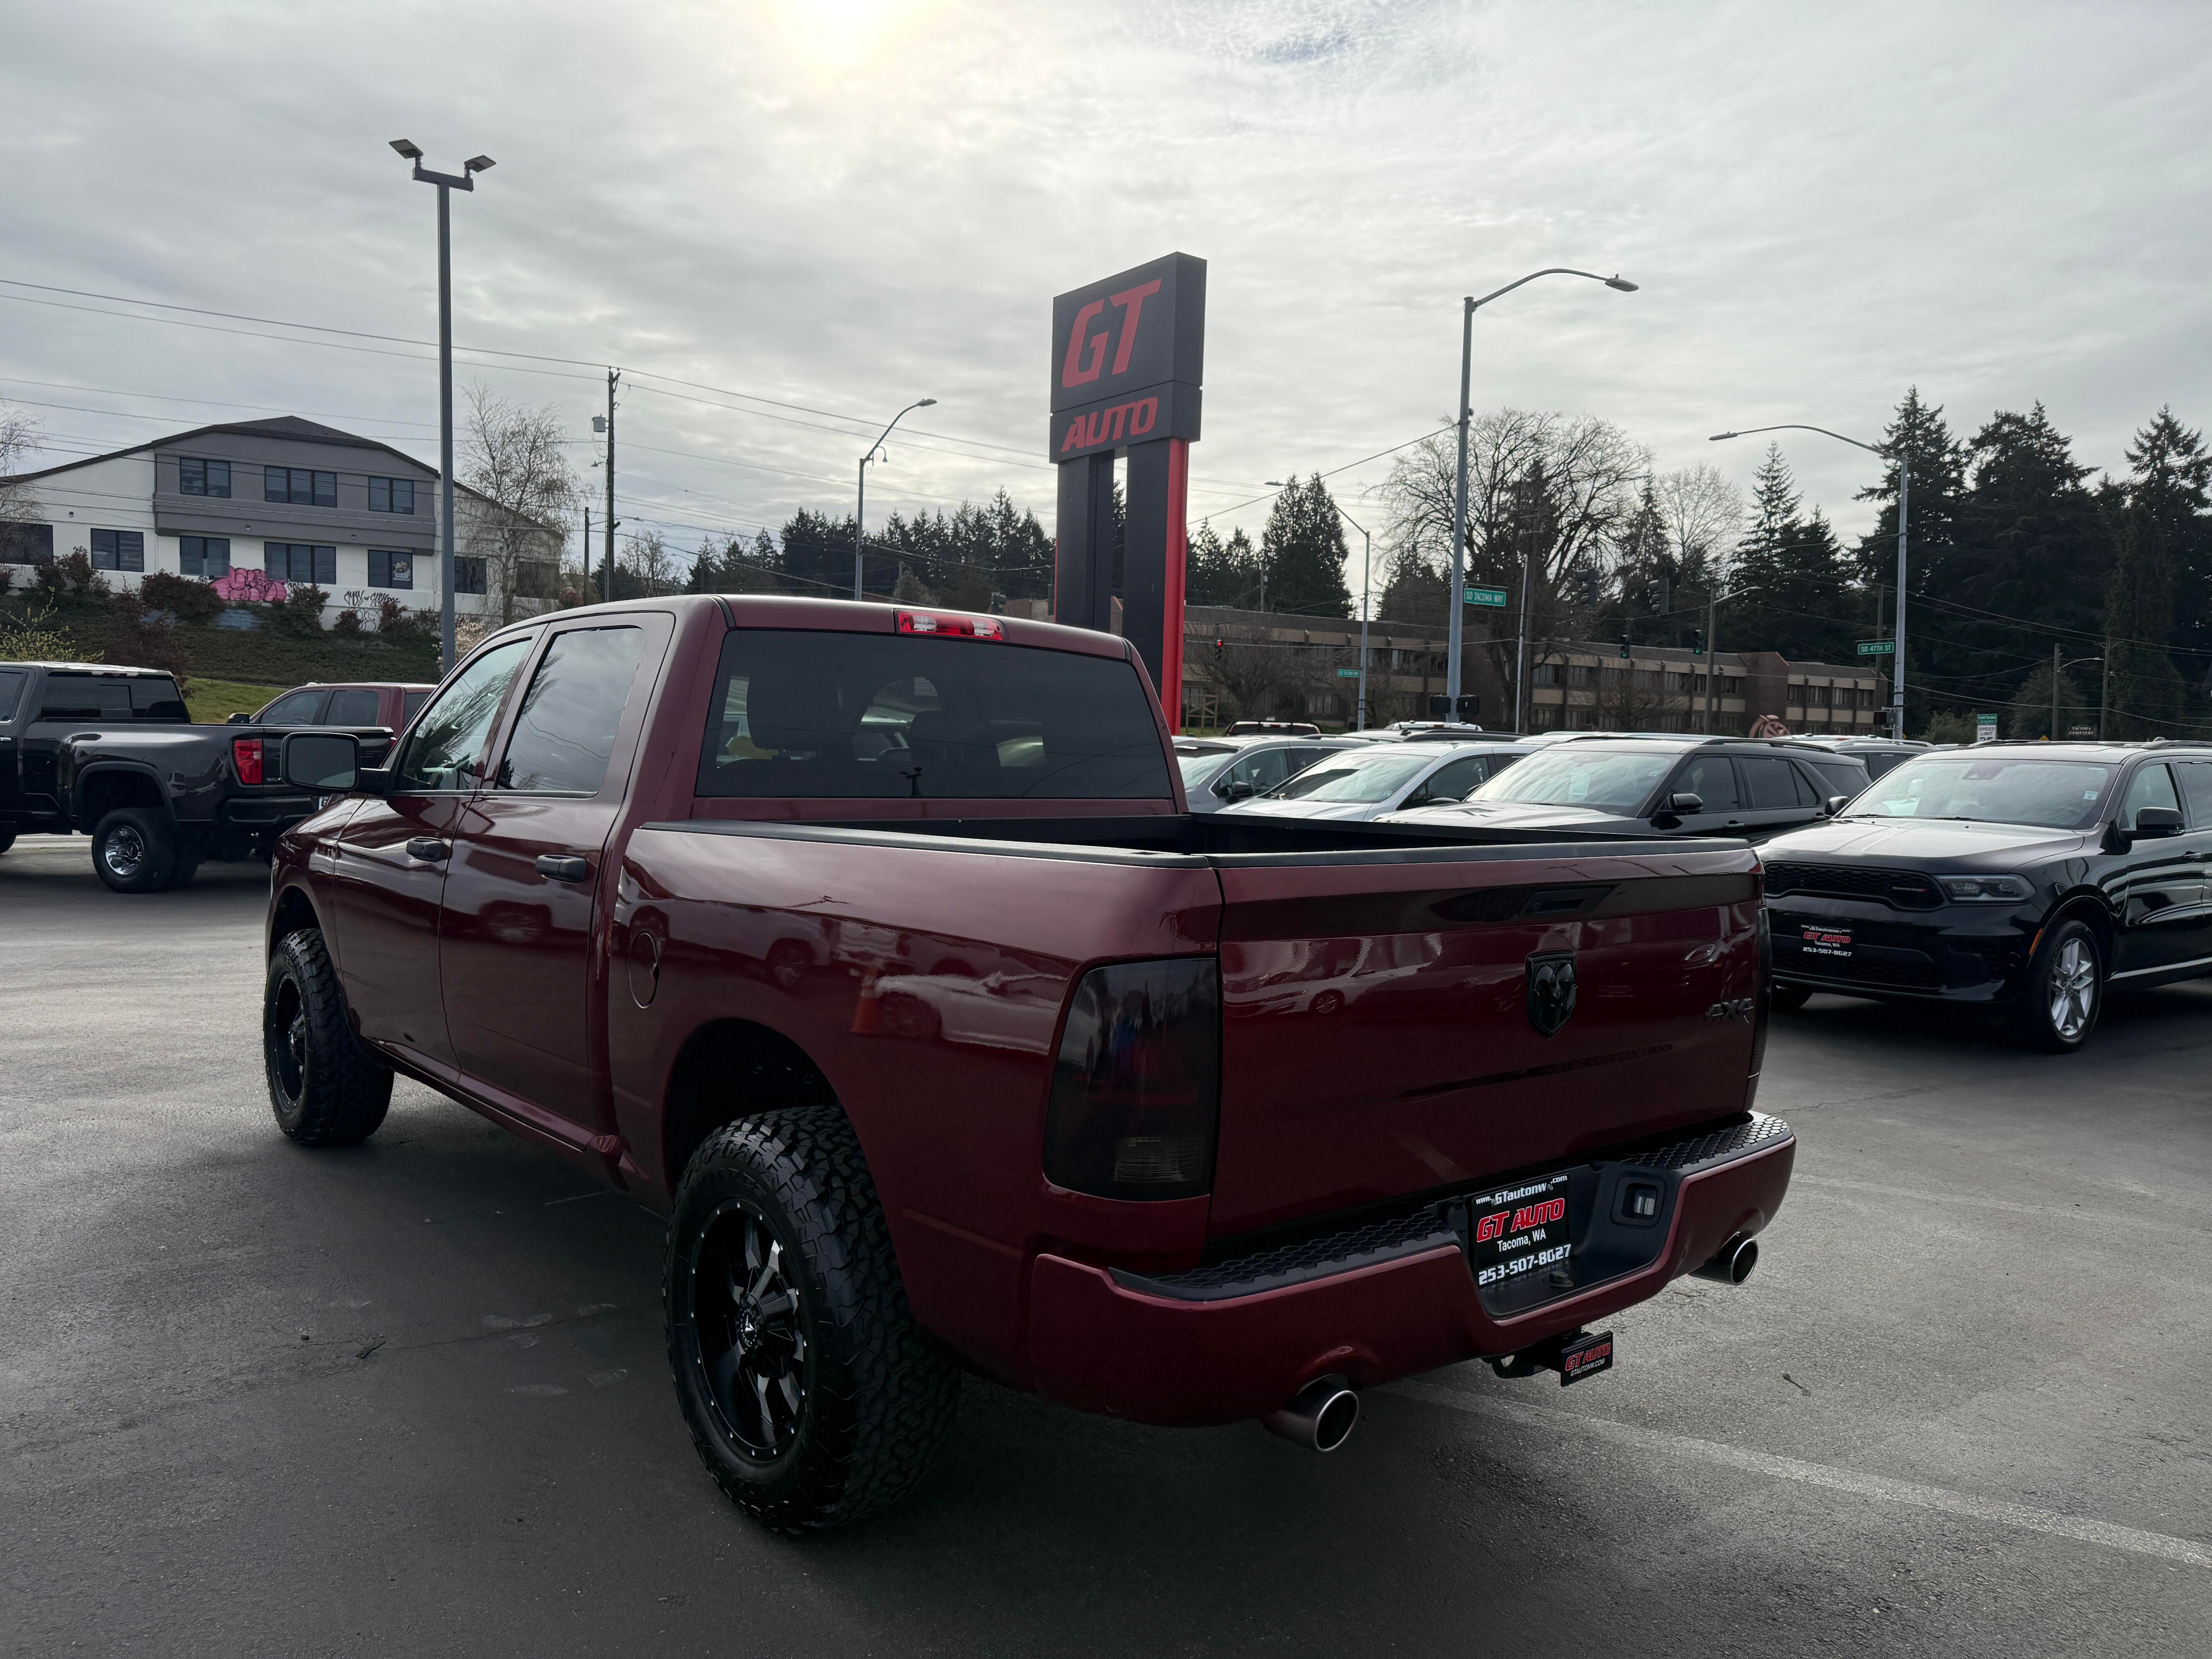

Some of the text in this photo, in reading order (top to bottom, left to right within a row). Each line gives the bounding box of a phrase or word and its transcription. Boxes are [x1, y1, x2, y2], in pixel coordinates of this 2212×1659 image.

[1062, 278, 1162, 388] GT
[1060, 396, 1158, 453] AUTO
[1466, 591, 1504, 603] SO TACOMA WAY
[1803, 931, 1851, 944] GT AUTO
[1477, 1198, 1565, 1243] GT AUTO
[1497, 1228, 1546, 1252] Tacoma, WA
[1479, 1244, 1571, 1285] 253-507-8027
[1565, 1342, 1611, 1371] GT AUTO
[1570, 1358, 1605, 1377] GTAUTONW.COM
